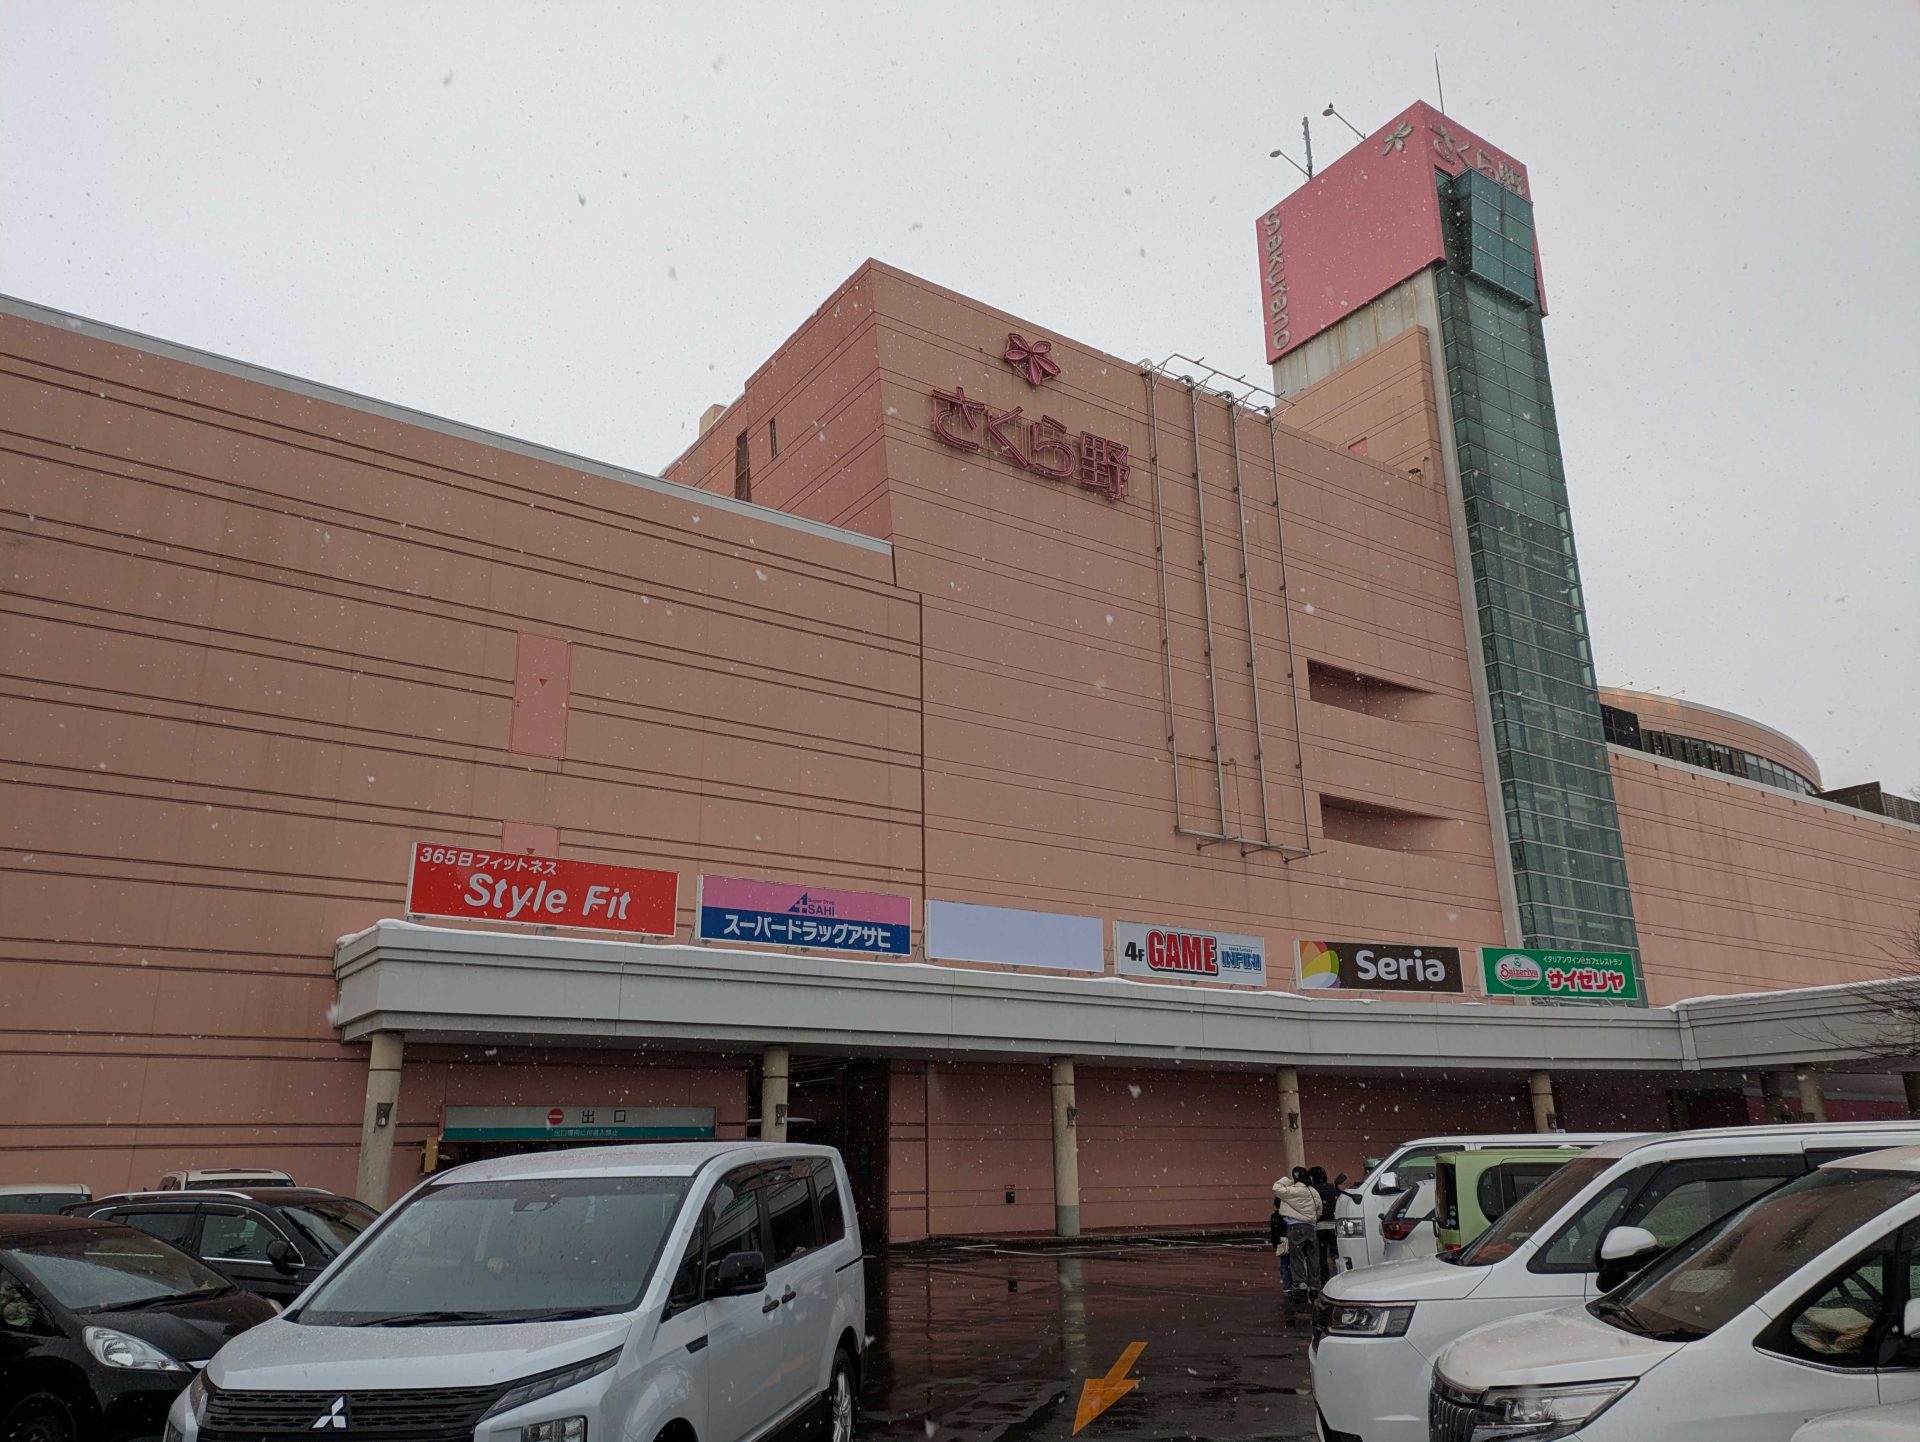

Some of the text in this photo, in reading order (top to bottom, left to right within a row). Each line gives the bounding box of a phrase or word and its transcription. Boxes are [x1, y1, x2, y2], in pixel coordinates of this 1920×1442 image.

[932, 386, 1130, 500] さくら野
[418, 846, 557, 876] 365日フィットネス
[463, 872, 631, 920] Style Fit
[723, 913, 892, 949] スーパードラッグアサヒ
[1124, 929, 1219, 976] 4F GAME
[1355, 949, 1446, 982] Seria
[1500, 963, 1539, 979] Saizeriya
[1547, 968, 1625, 992] サイゼリヤ
